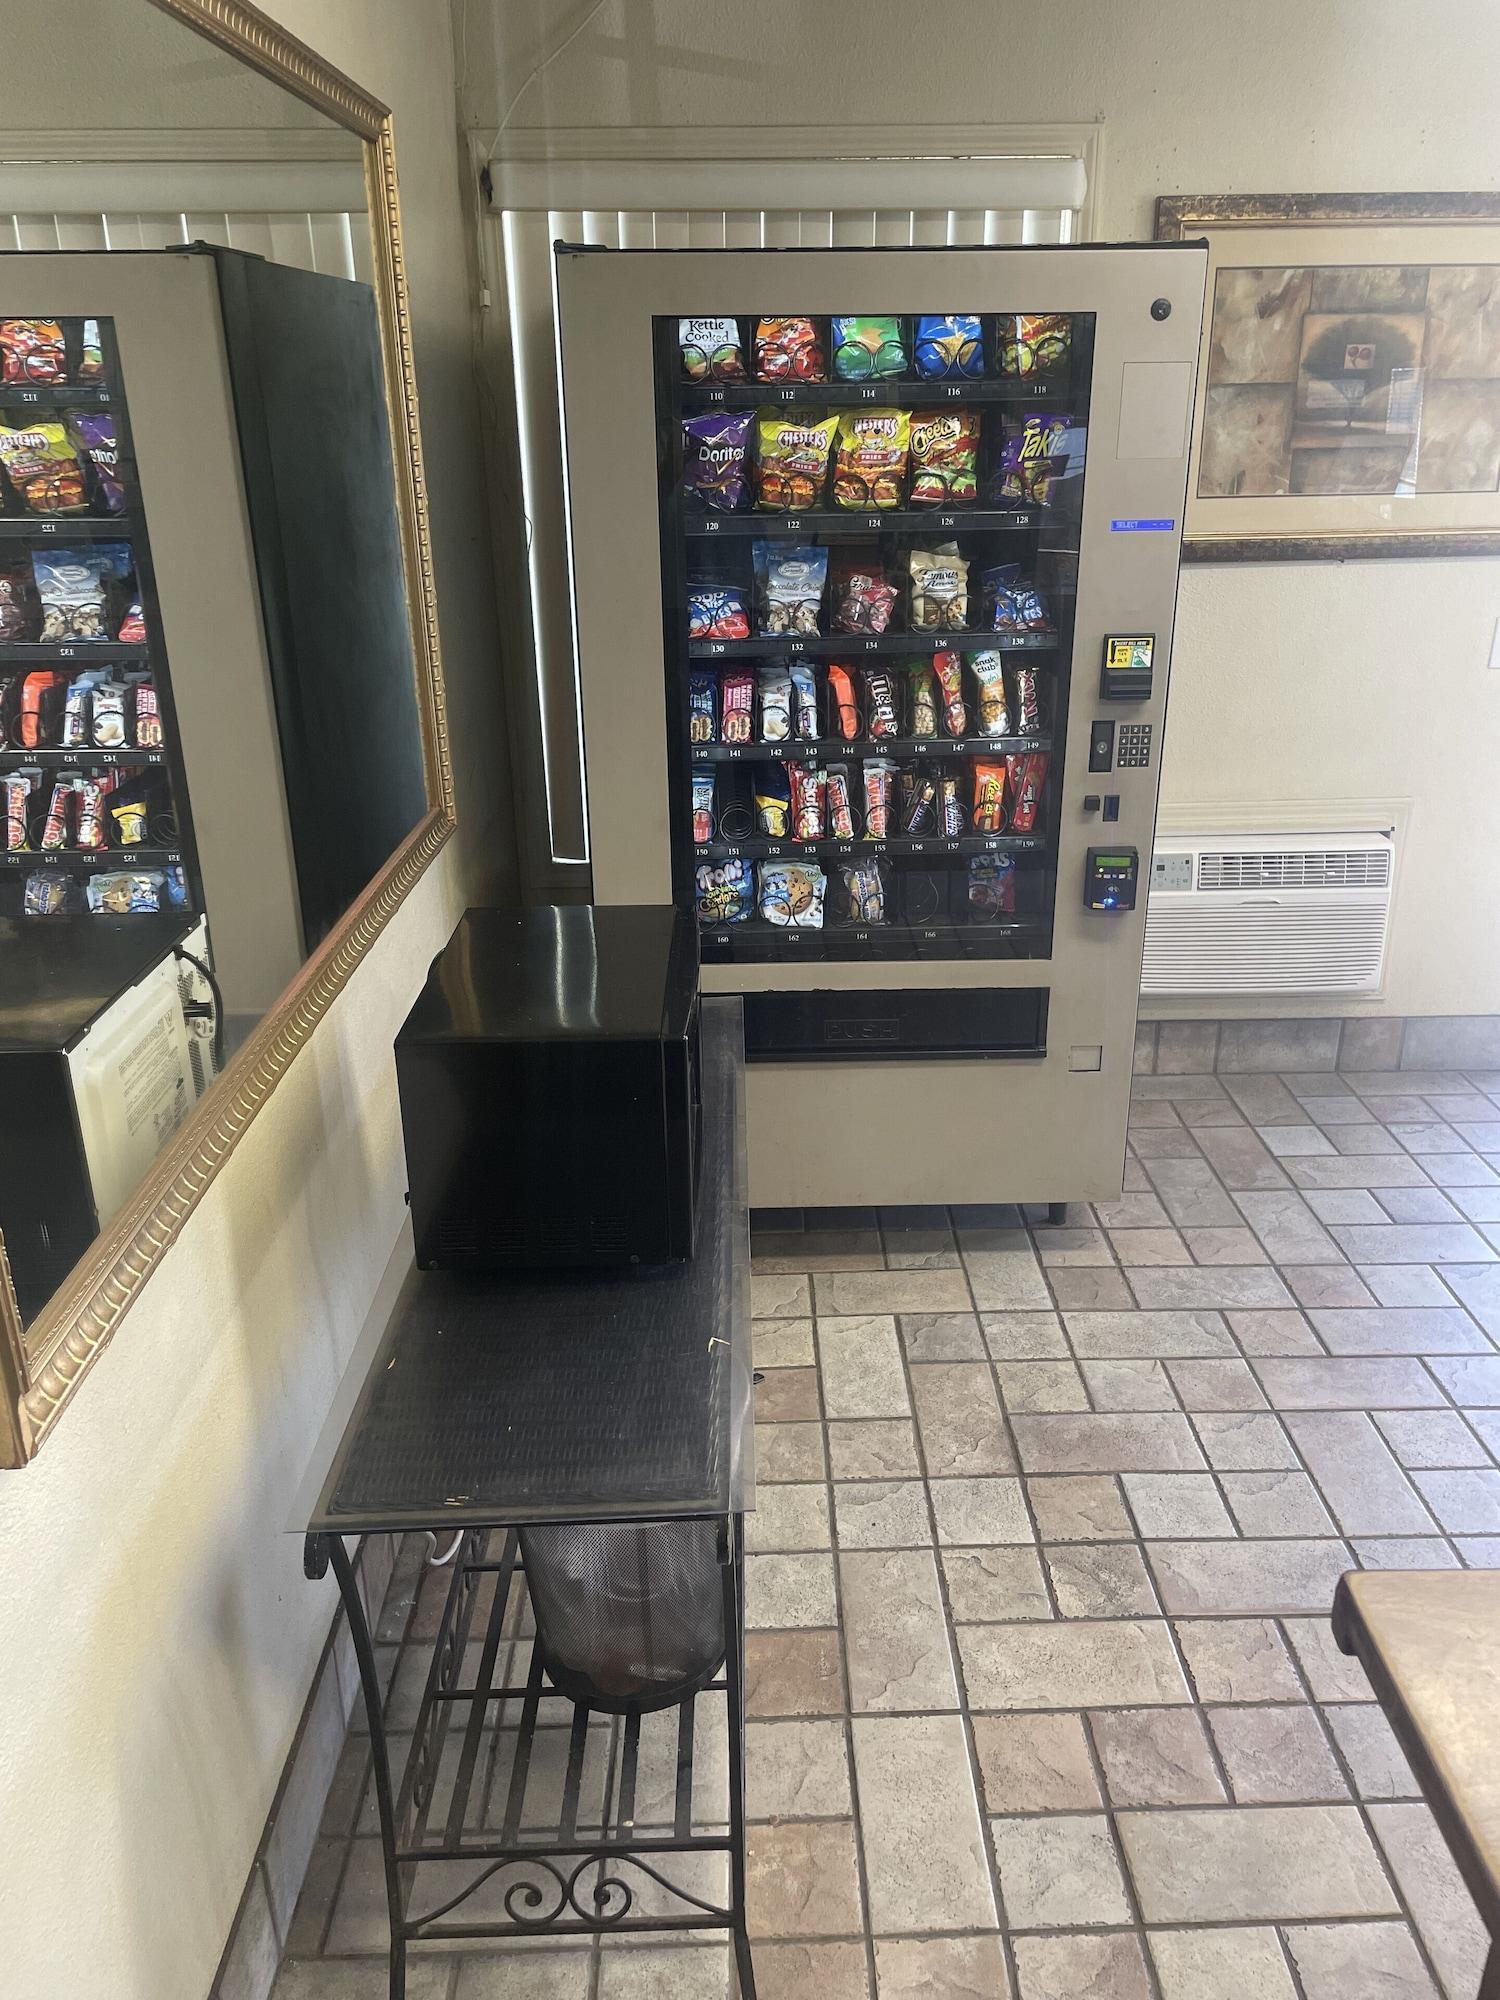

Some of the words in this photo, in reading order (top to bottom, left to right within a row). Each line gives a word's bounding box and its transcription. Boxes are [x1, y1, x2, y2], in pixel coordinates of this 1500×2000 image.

[688, 320, 724, 333] Kettle
[685, 330, 729, 343] Cooked
[862, 389, 875, 398] 114
[947, 388, 961, 396] 116
[1033, 386, 1047, 394] 118
[710, 392, 723, 400] 110
[781, 391, 795, 399] 112
[1018, 427, 1068, 462] Takis
[698, 445, 746, 462] Doritos
[868, 519, 881, 527] 124
[941, 518, 954, 526] 126
[1016, 516, 1029, 524] 128
[705, 522, 719, 530] 120
[787, 521, 800, 529] 122
[1011, 638, 1025, 646] 138
[712, 645, 725, 653] 130
[791, 643, 804, 651] 132
[974, 656, 996, 667] snak
[977, 664, 997, 674] club
[983, 778, 1001, 817] Reee's
[696, 848, 708, 856] 150
[717, 936, 729, 944] 160
